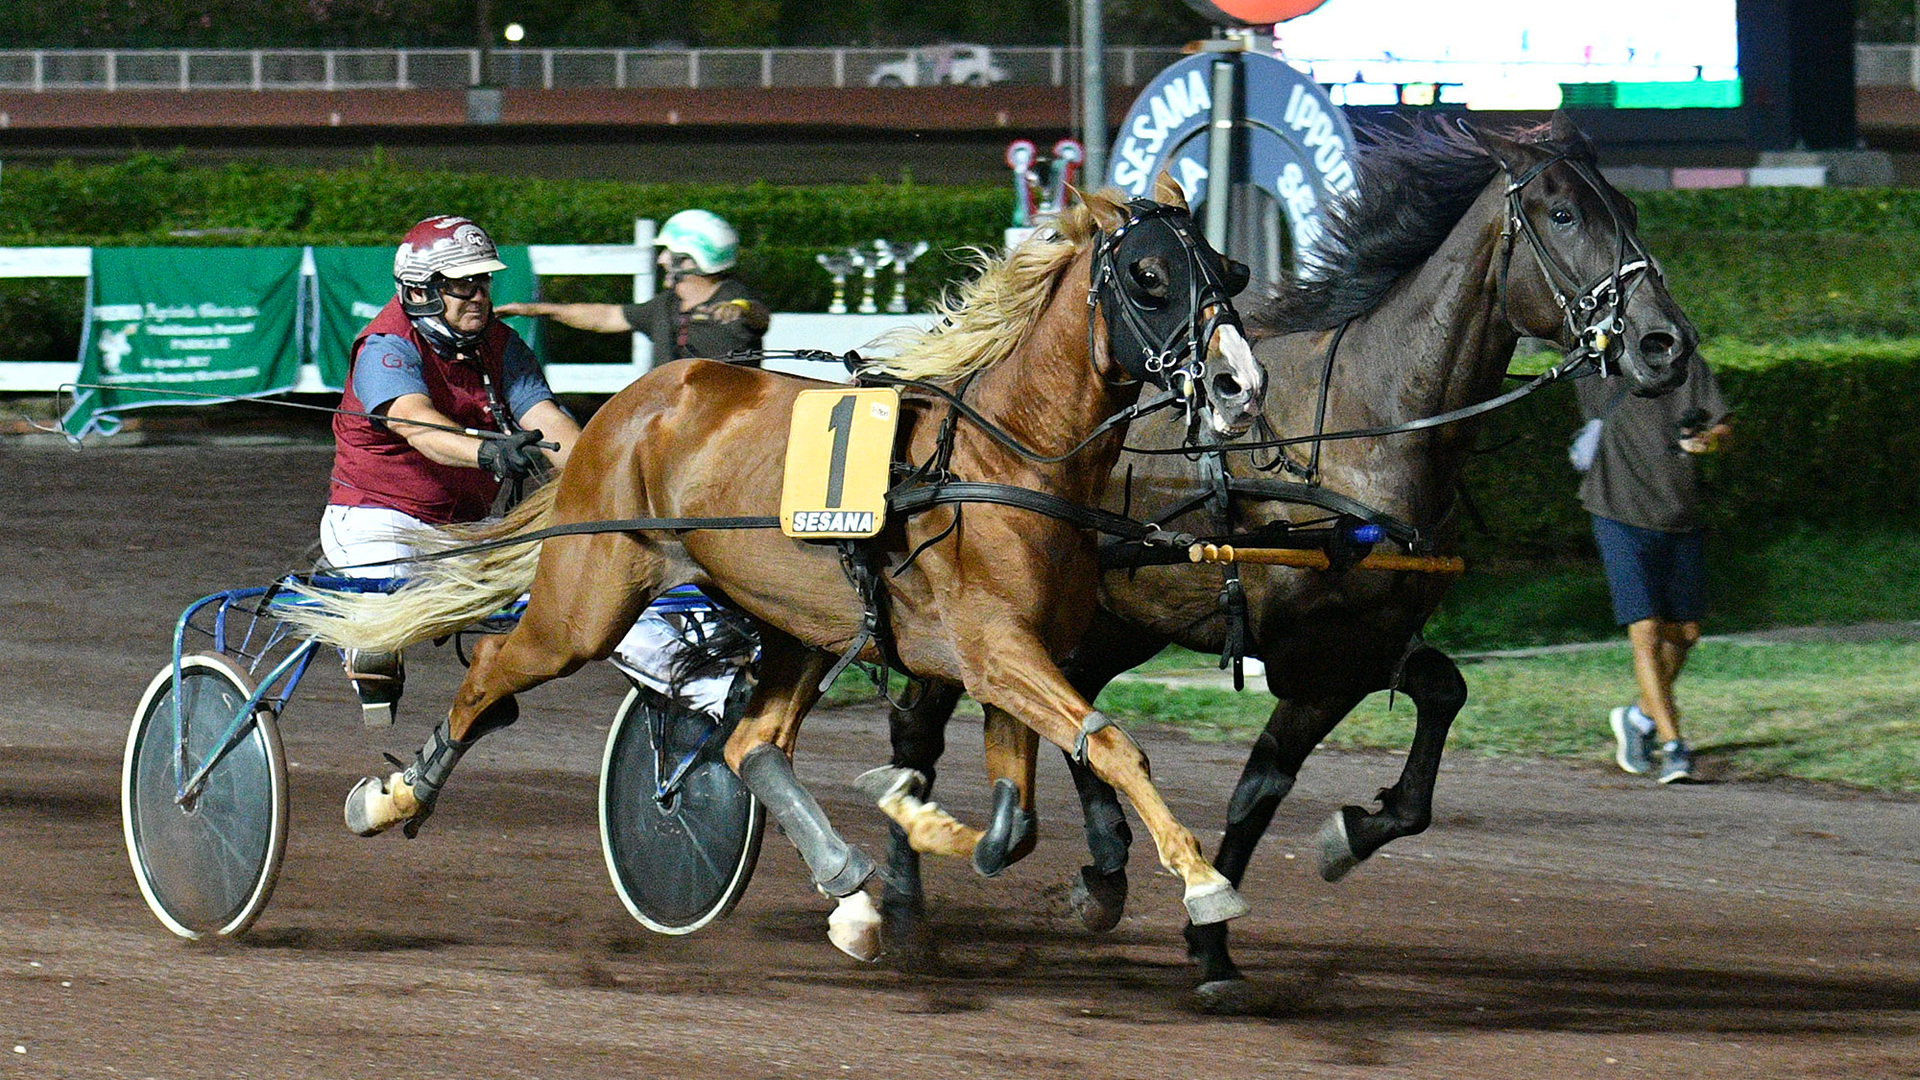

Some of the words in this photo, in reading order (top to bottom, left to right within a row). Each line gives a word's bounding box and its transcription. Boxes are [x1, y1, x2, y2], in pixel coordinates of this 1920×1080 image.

[1114, 70, 1211, 194] SESANA
[1283, 83, 1364, 208] IPPOD
[825, 395, 857, 508] 1
[793, 512, 872, 532] SESANA
